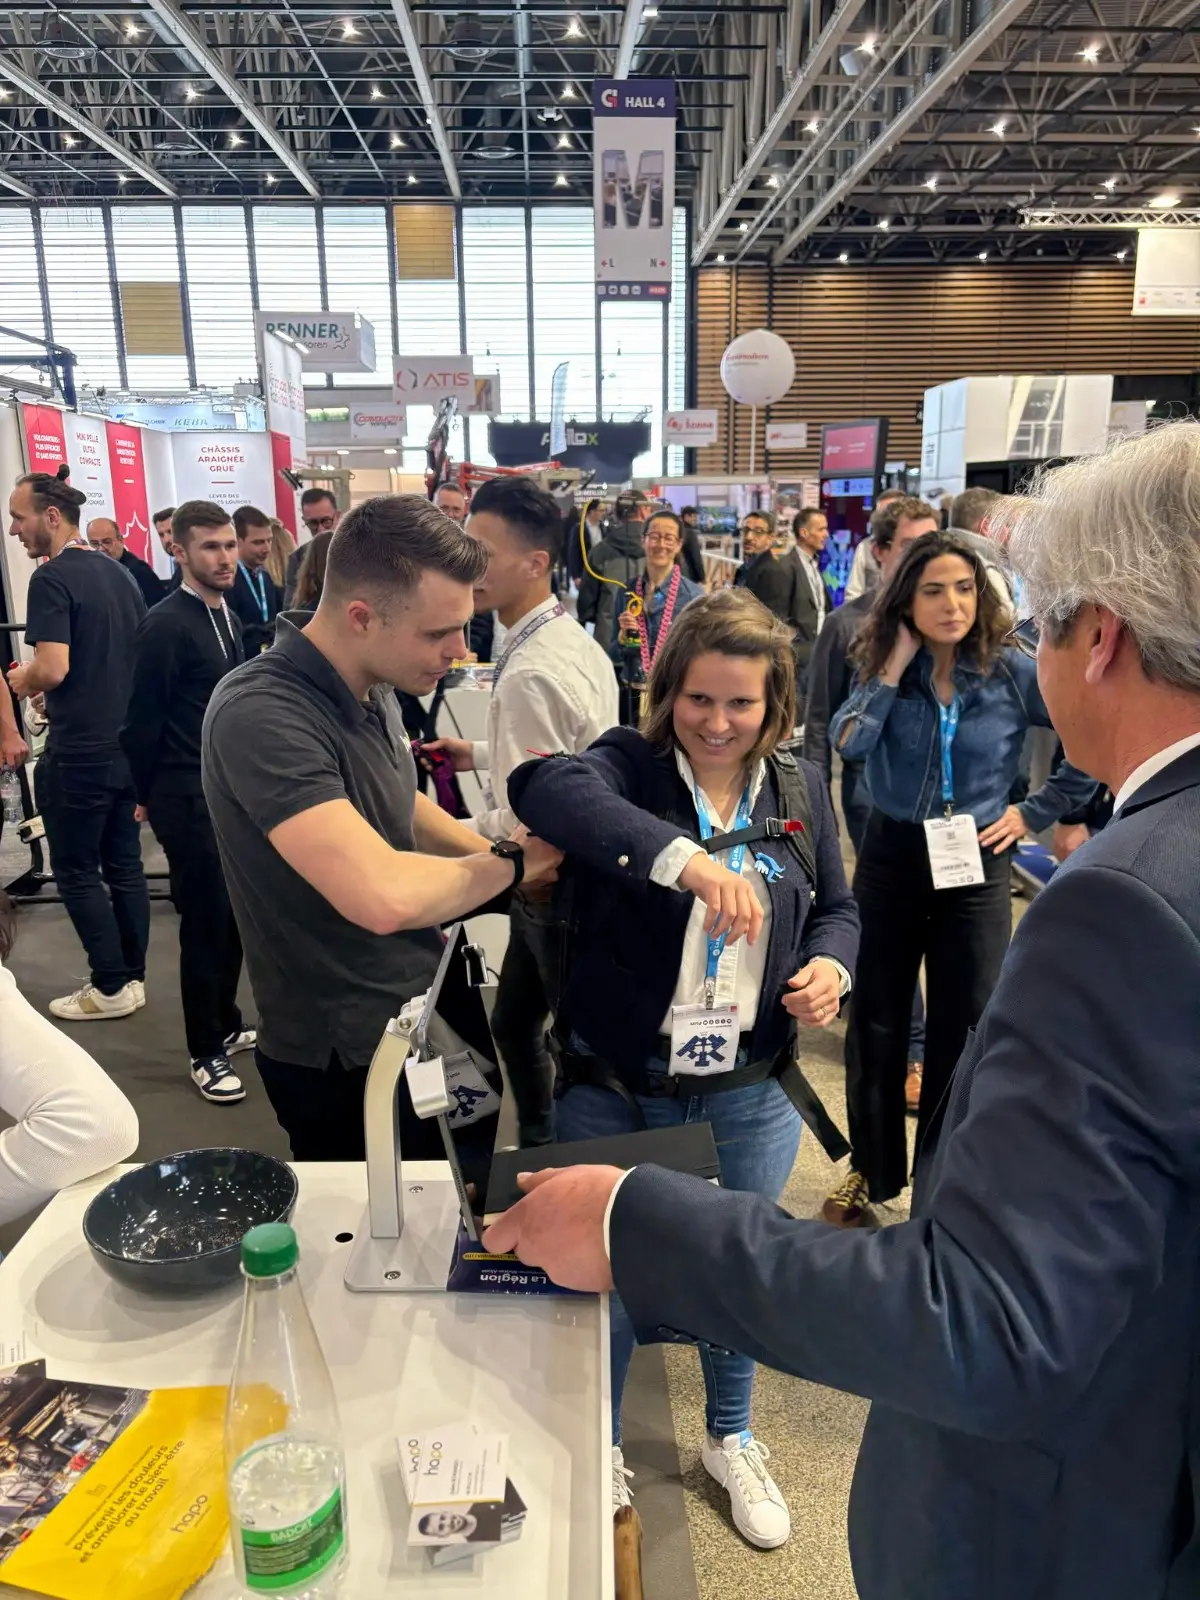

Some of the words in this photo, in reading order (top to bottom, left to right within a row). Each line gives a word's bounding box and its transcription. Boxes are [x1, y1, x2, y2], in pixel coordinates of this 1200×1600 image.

[625, 97, 654, 108] HALL
[657, 97, 666, 108] 4
[601, 150, 664, 229] M
[609, 258, 615, 268] L
[650, 258, 657, 268] N
[423, 373, 470, 387] ATIS
[83, 445, 96, 454] ULTRA
[79, 457, 101, 466] COMPACTE
[198, 455, 245, 463] ARAIGNÉE
[480, 1273, 528, 1285] Région
[531, 1275, 547, 1284] La
[423, 1441, 443, 1475] hapo
[74, 1507, 116, 1551] Prévenir
[112, 1490, 131, 1506] les
[129, 1445, 168, 1489] douleurs
[80, 1552, 93, 1563] et
[91, 1498, 138, 1549] améliorer
[134, 1487, 147, 1496] le
[144, 1440, 185, 1485] bien-être
[124, 1512, 140, 1528] au
[136, 1478, 169, 1511] travail
[171, 1494, 208, 1532] hapo
